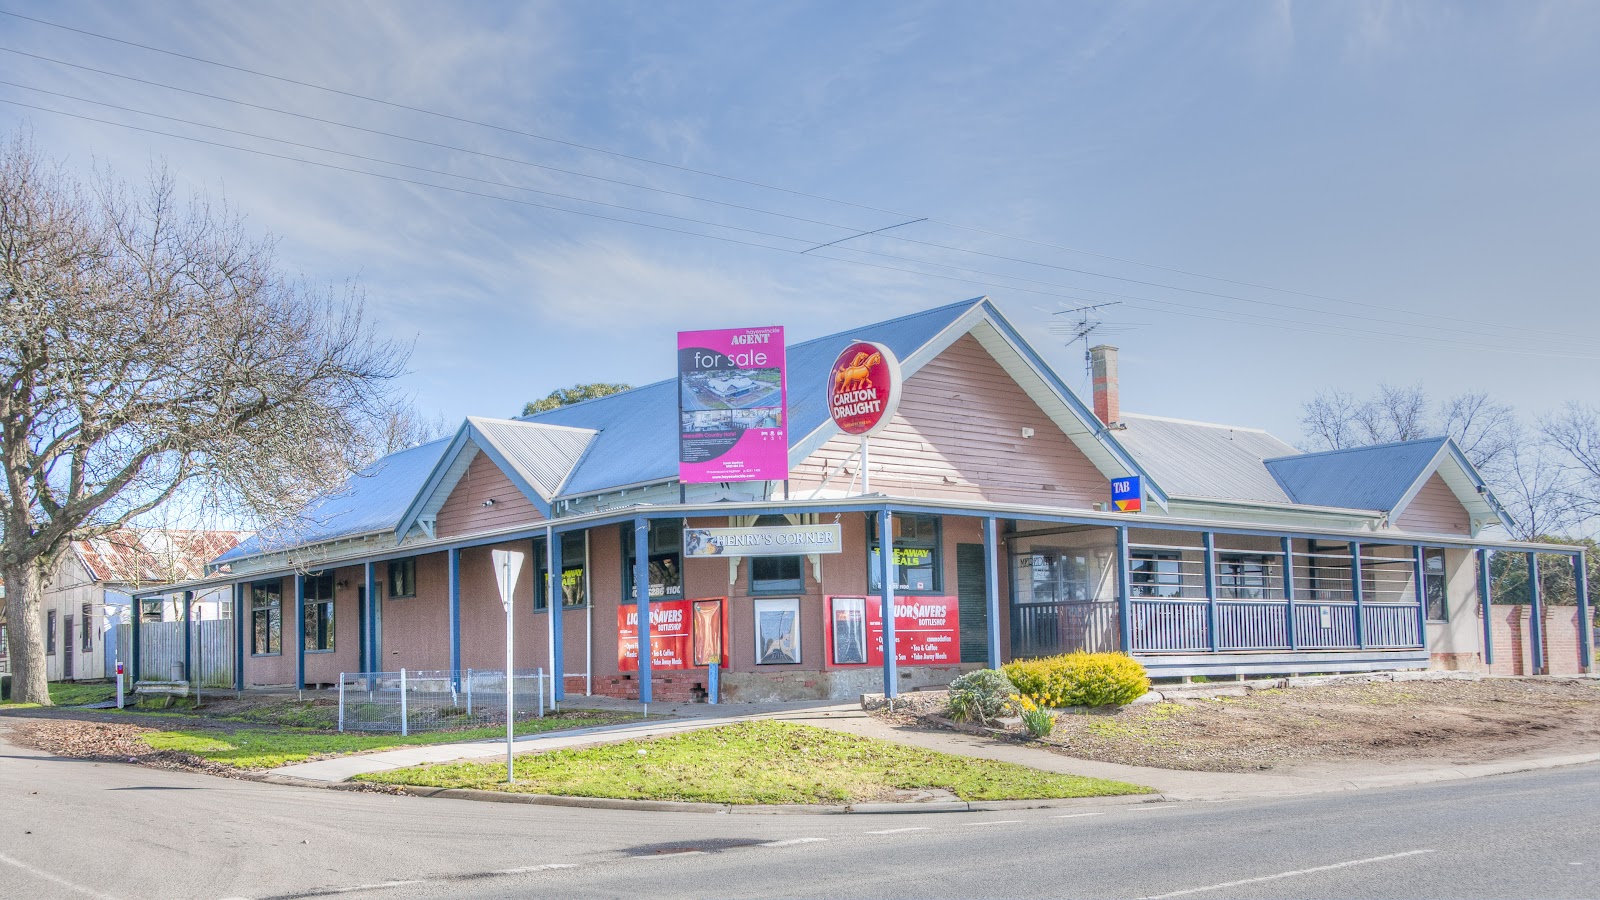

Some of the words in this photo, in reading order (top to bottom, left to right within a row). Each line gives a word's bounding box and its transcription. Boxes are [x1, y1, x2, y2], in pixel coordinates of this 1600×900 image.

[731, 333, 770, 345] AGENT
[694, 352, 721, 368] for
[727, 349, 767, 367] sale
[833, 388, 877, 406] CARLTON
[833, 400, 881, 419] DRAUGHT
[1113, 481, 1130, 494] TAB
[716, 533, 772, 547] HENRY'S
[776, 531, 834, 545] CORNER
[919, 618, 946, 626] BOTTLESHOP
[924, 653, 935, 661] Away
